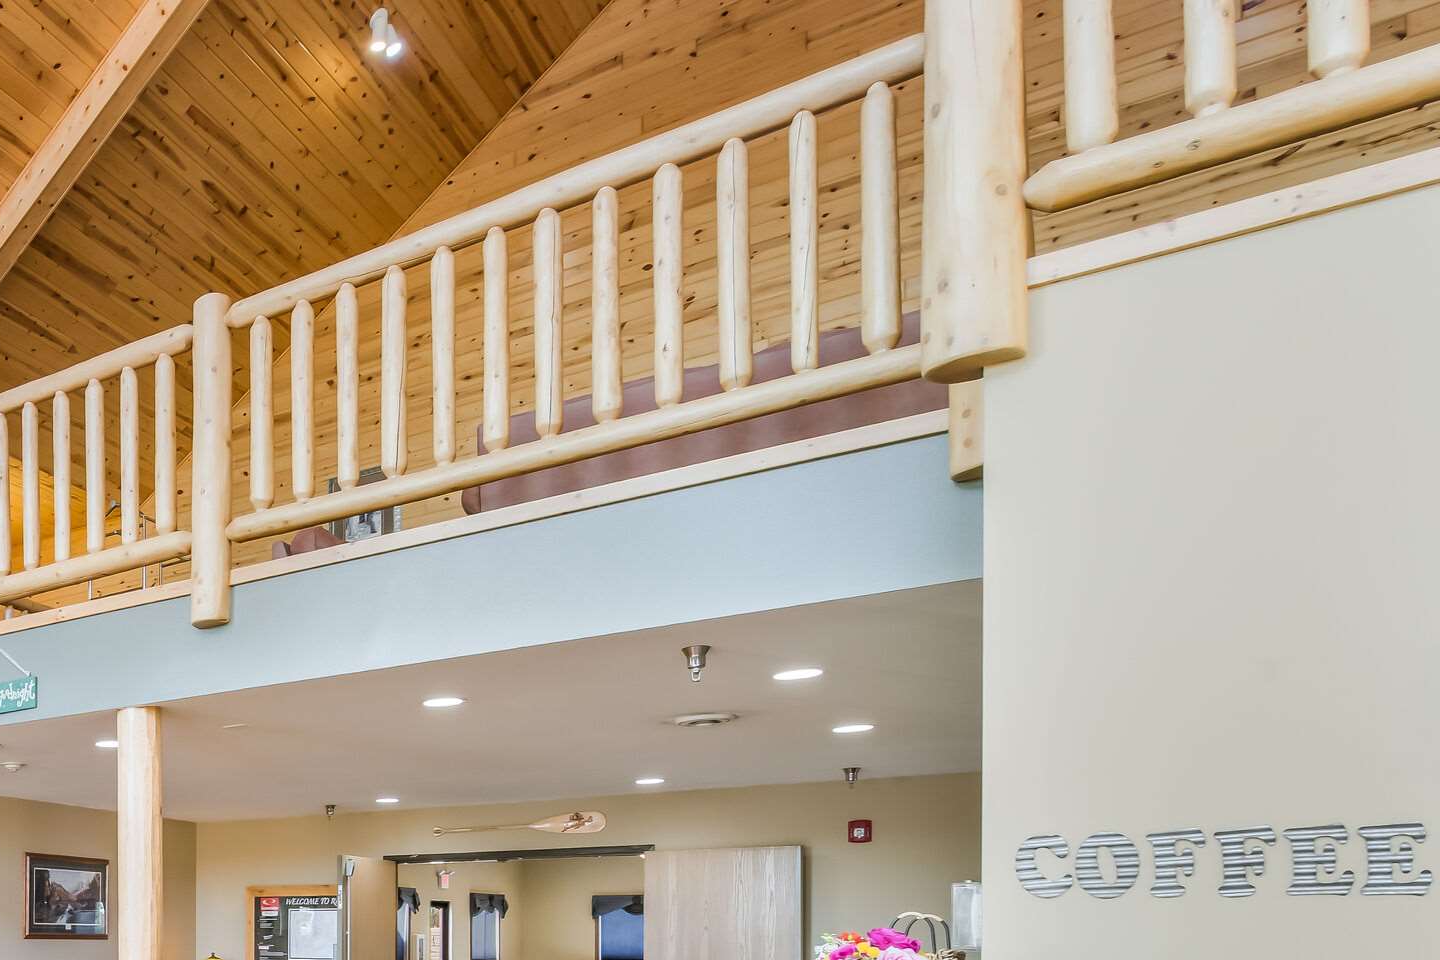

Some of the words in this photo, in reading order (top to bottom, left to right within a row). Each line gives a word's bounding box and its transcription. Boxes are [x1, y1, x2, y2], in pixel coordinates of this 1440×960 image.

[1015, 822, 1433, 899] COFFEE
[286, 897, 319, 905] WELCOME
[320, 897, 330, 905] TO
